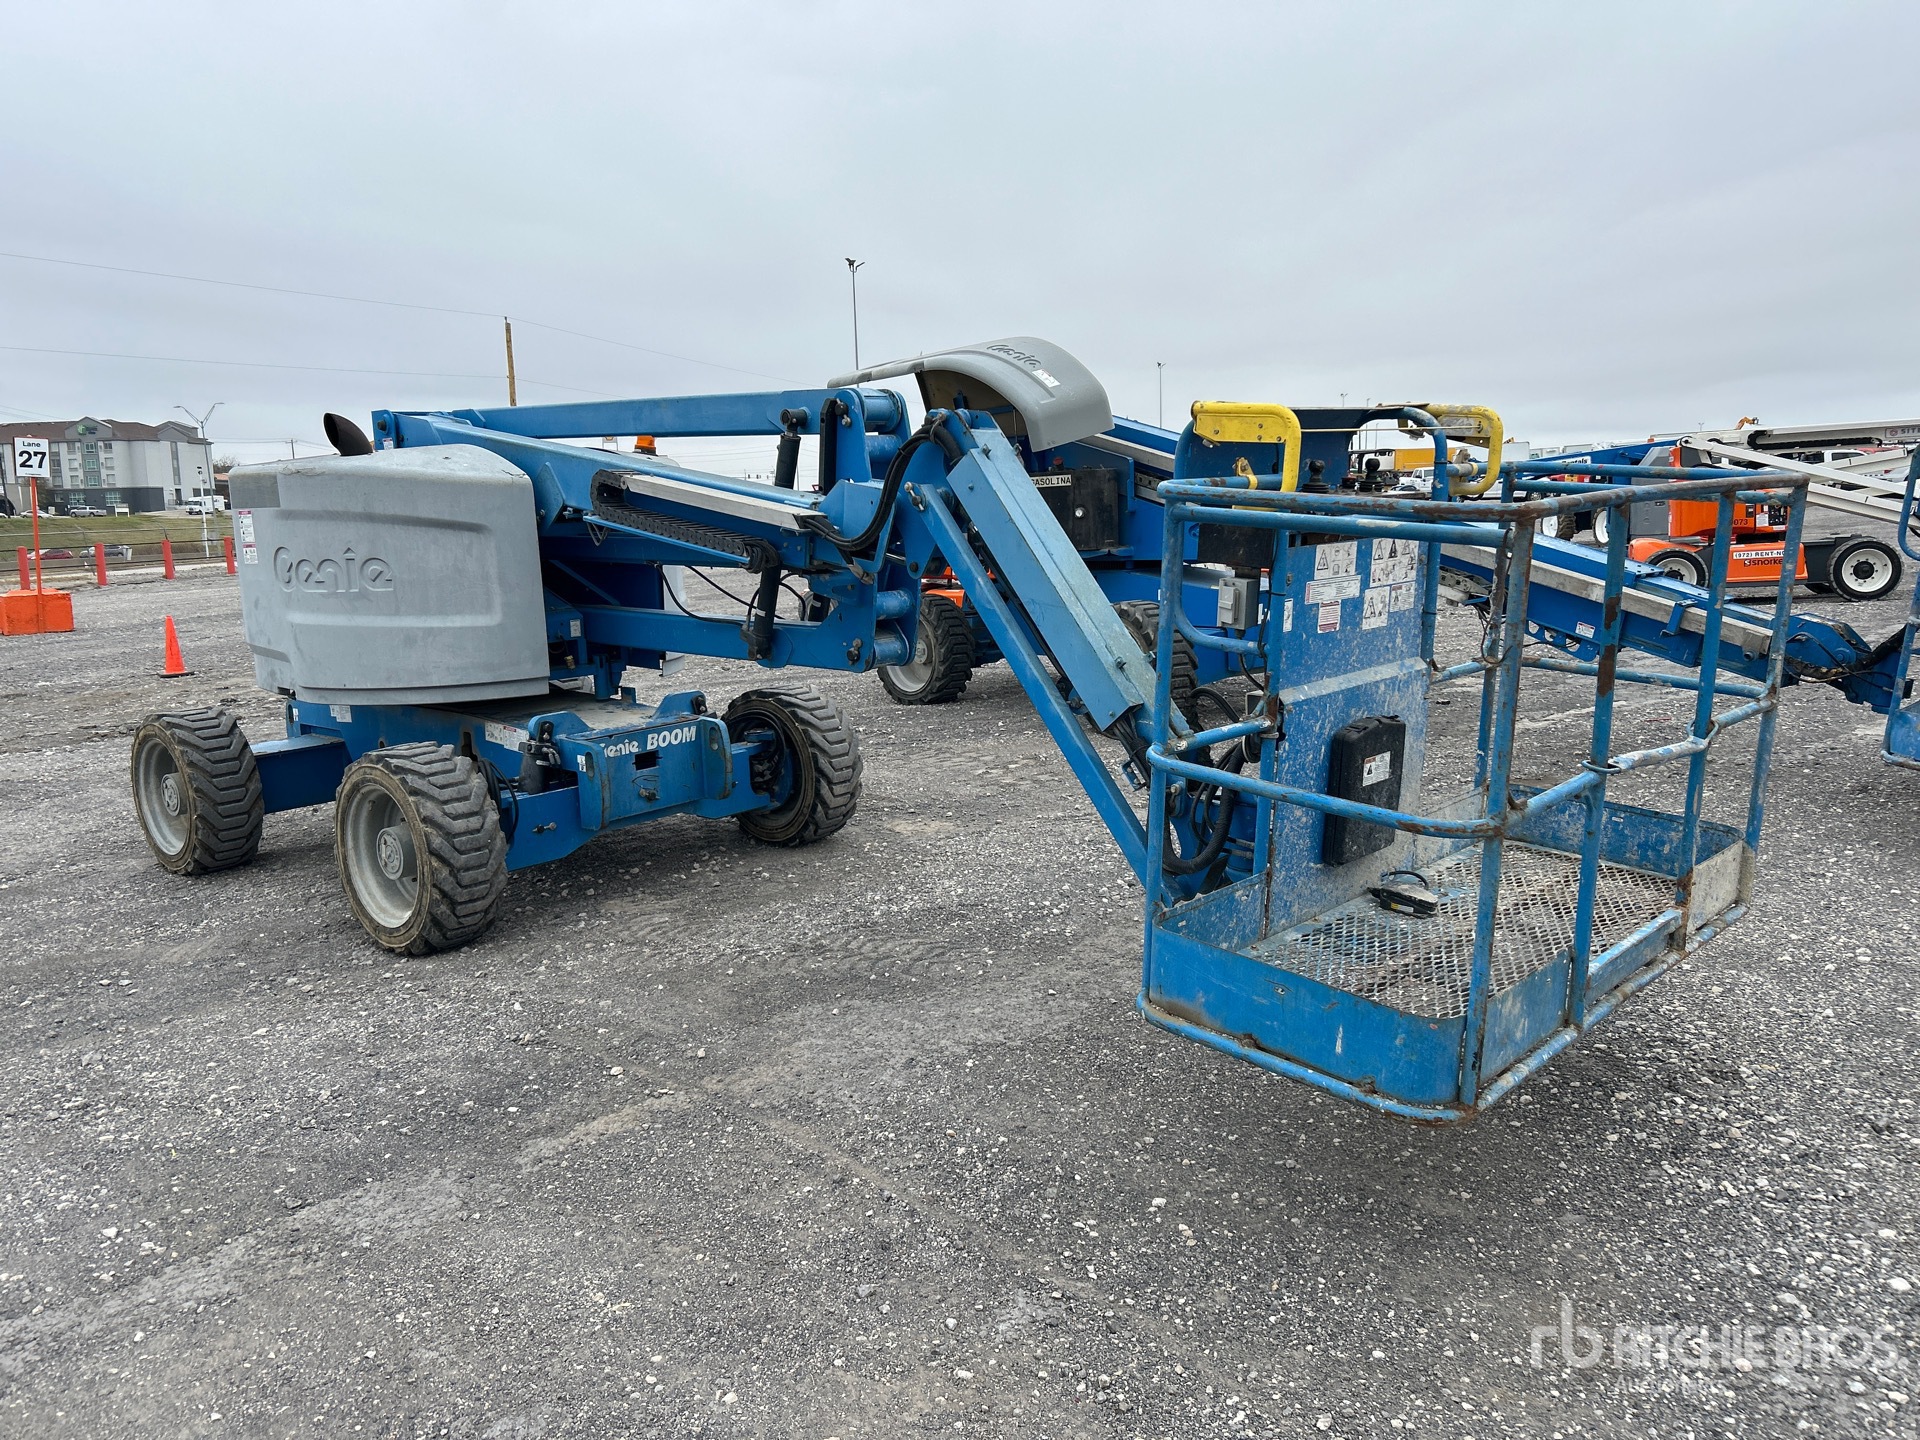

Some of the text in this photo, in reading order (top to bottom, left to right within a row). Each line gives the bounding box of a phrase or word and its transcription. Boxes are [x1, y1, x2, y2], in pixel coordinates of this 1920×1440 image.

[18, 450, 47, 469] 27
[1734, 551, 1753, 559] (972)
[273, 546, 394, 593] Genie
[646, 725, 697, 750] BOOM
